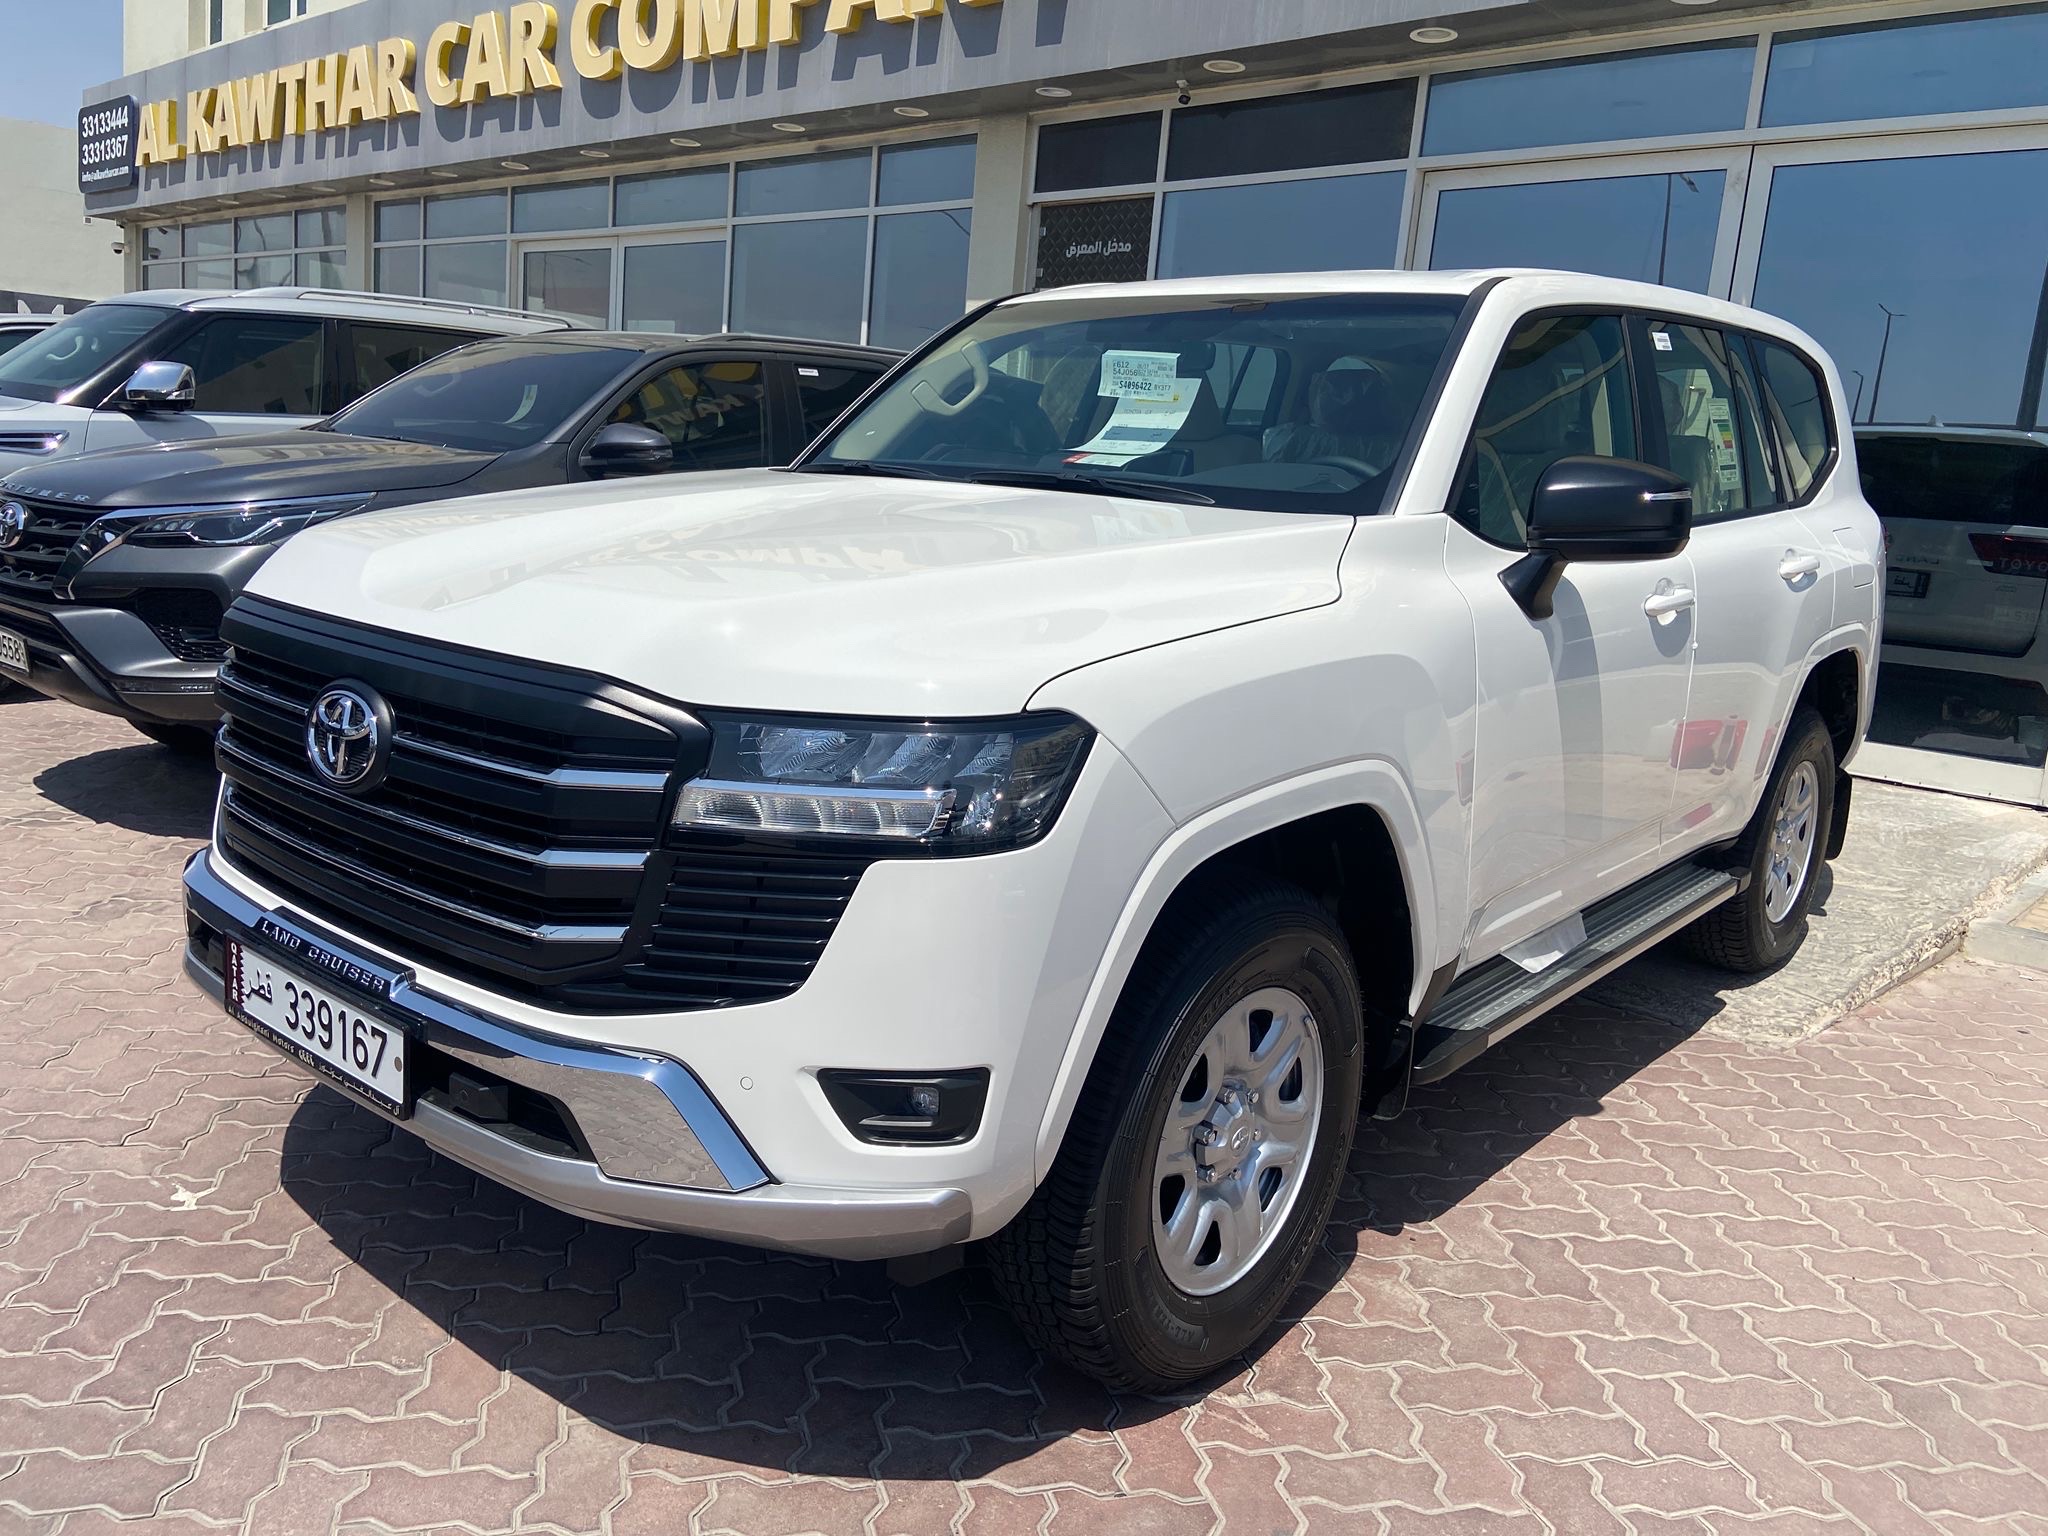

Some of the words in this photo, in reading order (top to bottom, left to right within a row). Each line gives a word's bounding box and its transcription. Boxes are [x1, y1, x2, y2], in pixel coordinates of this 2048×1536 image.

[135, 101, 187, 167] AL
[186, 37, 421, 154] KAWTHAR
[424, 1, 563, 108] CAR
[82, 106, 128, 138] 33133444
[82, 134, 128, 165] 33313367
[1066, 241, 1102, 258] المعرض
[1103, 238, 1131, 256] مدخل
[230, 942, 239, 1002] QATAR
[262, 920, 301, 950] LAND
[308, 945, 385, 992] CRUISER
[244, 968, 273, 1004] قطر
[272, 1031, 295, 1054] Motors
[284, 981, 388, 1080] 339167
